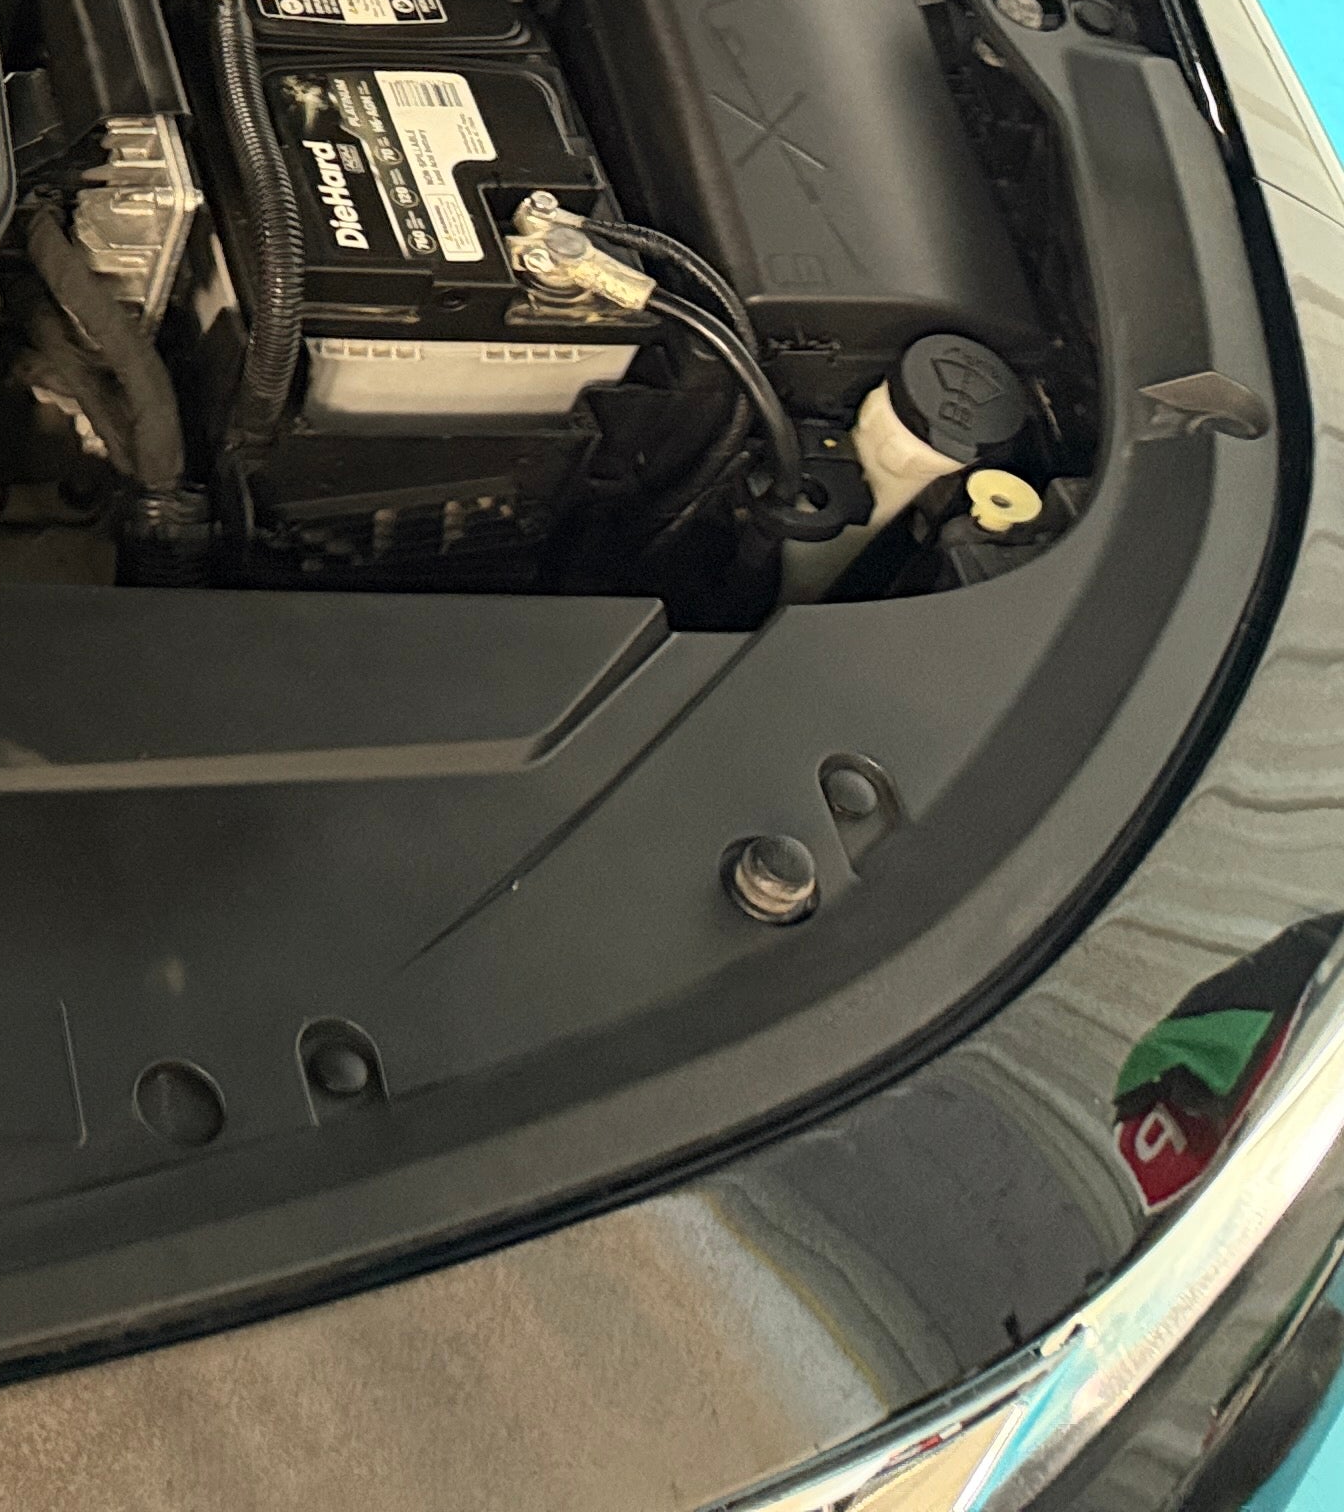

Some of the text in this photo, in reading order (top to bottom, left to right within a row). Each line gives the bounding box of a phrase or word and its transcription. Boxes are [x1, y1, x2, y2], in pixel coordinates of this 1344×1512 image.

[333, 78, 361, 128] PLATINUM
[301, 139, 370, 250] DieHard
[395, 186, 412, 204] 120
